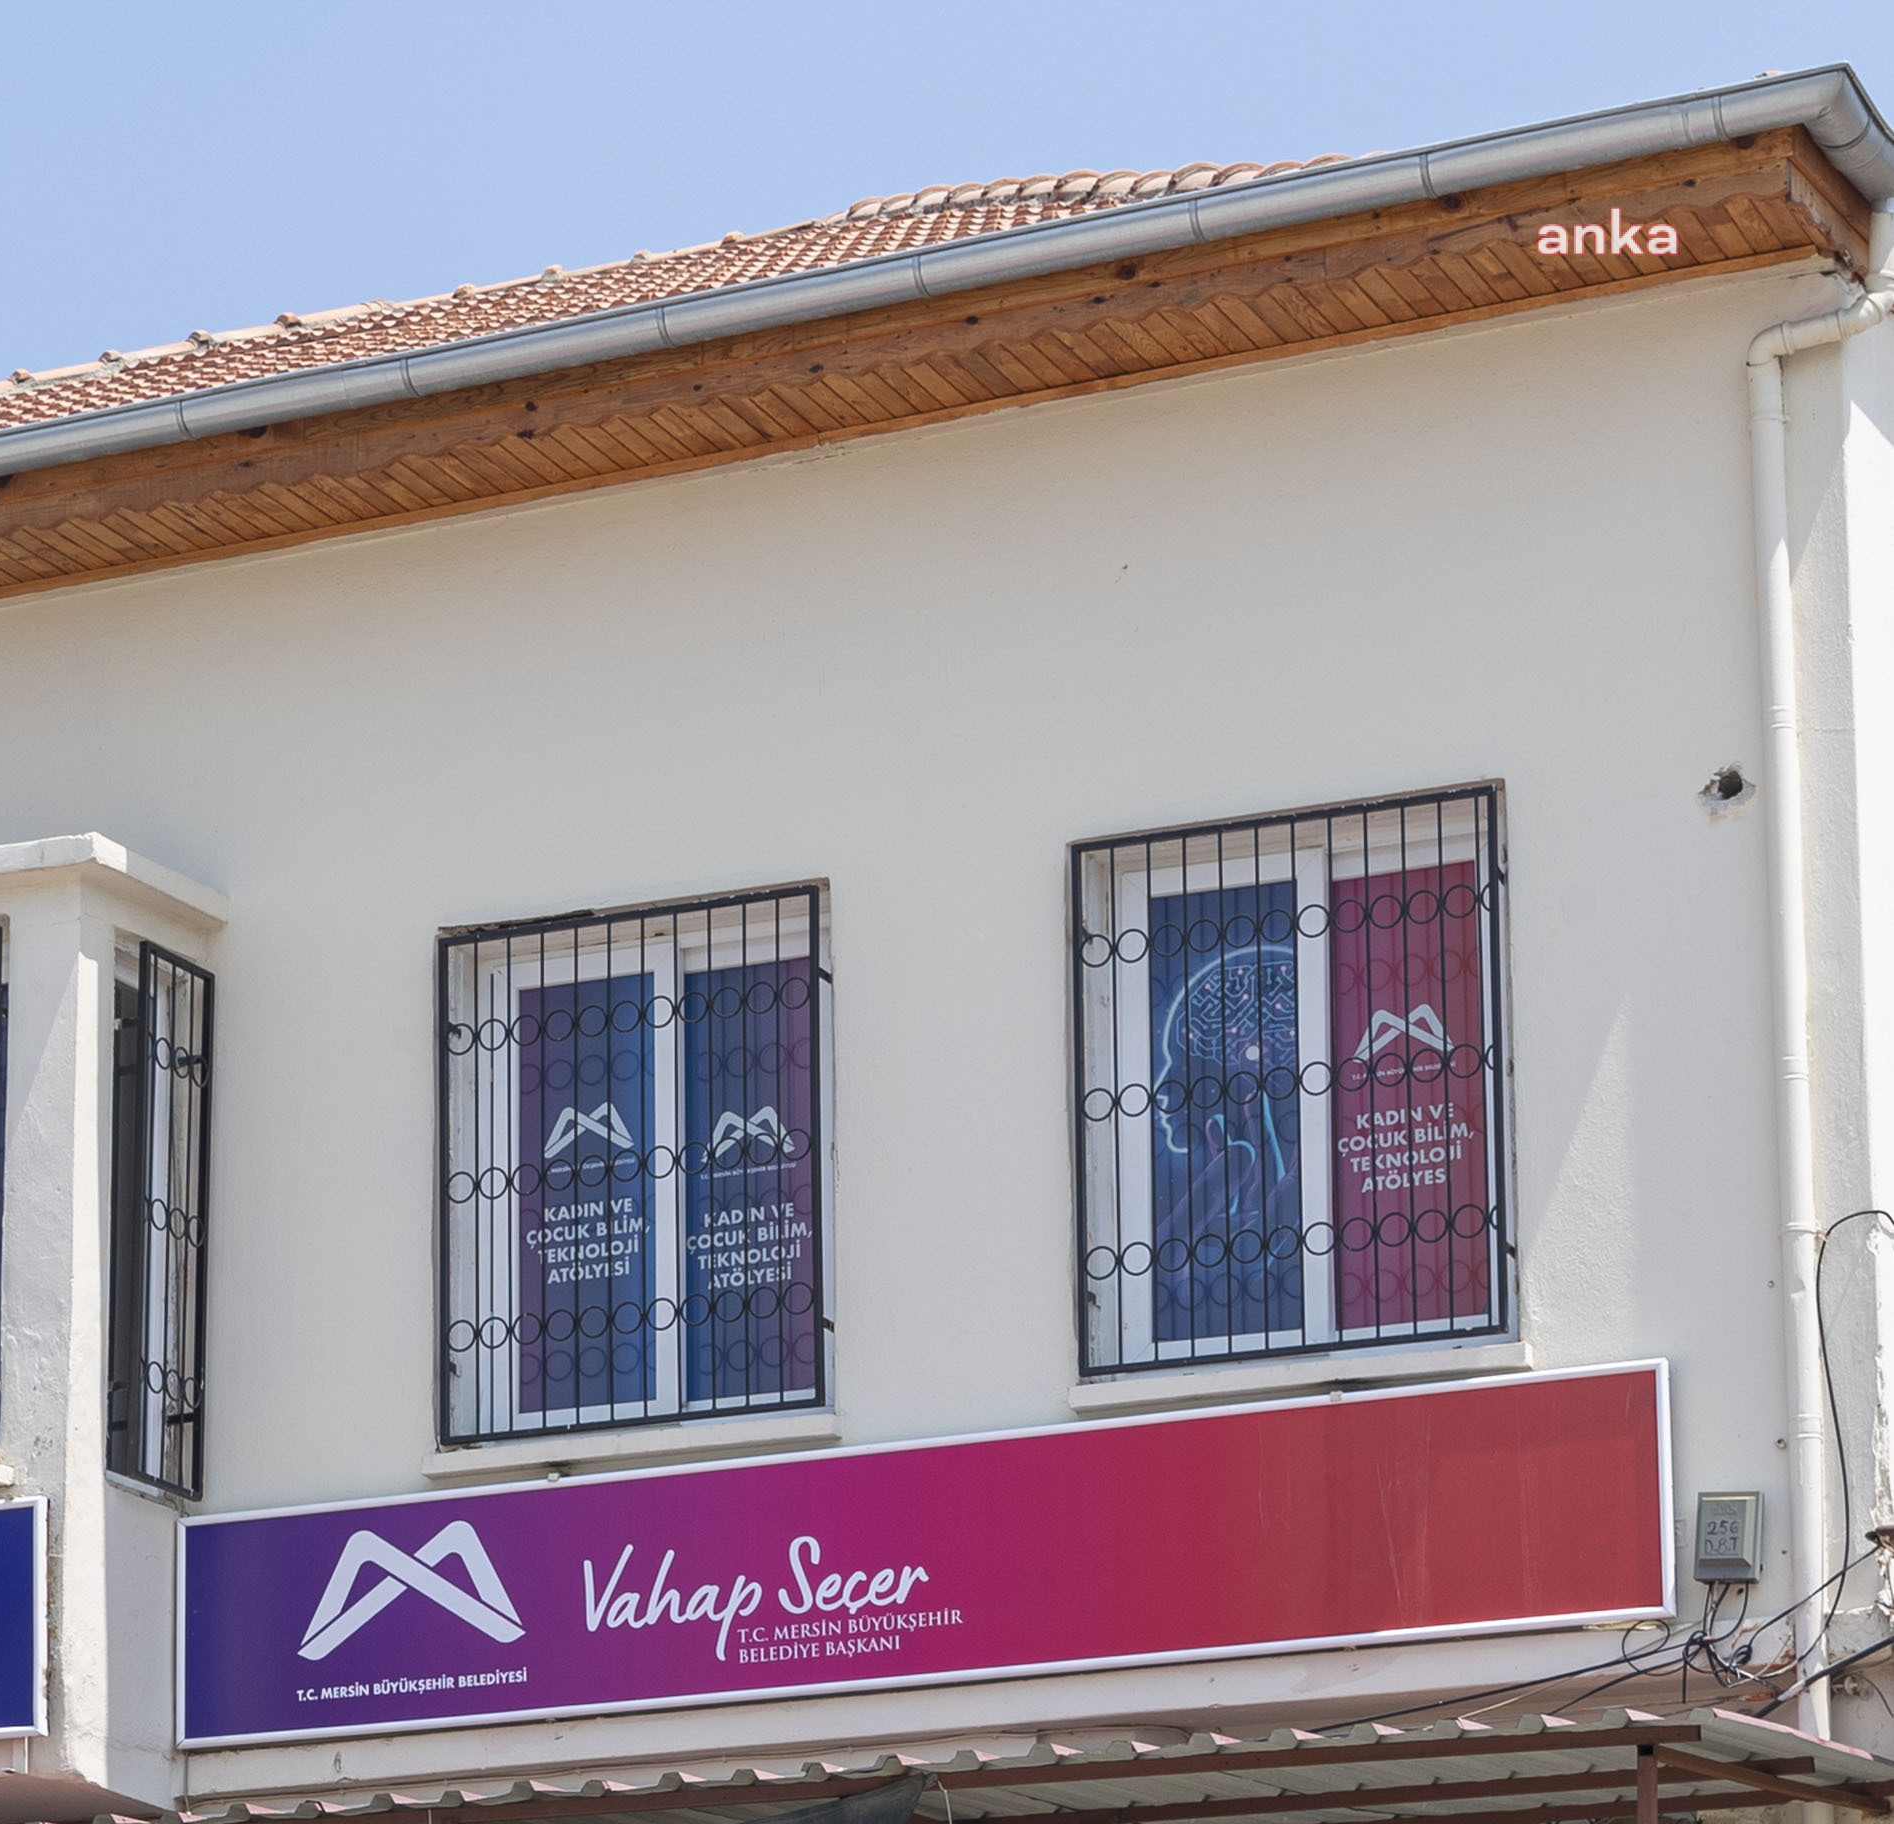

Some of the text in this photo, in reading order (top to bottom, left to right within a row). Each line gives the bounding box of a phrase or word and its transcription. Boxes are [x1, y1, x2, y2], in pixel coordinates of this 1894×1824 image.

[1356, 1106, 1422, 1130] KADIN
[1362, 1168, 1447, 1194] ATÖLYES
[544, 1198, 633, 1223] KADIN VE
[526, 1215, 651, 1250] ÇOCUK BLİM,
[583, 1535, 930, 1662] Vahap Seçer
[737, 1607, 964, 1645] T.C. MERSİN BÜYÜKŞEHİR
[738, 1635, 901, 1664] BELEDİYE BAŞKANI
[297, 1666, 527, 1702] T.C. MERSİN BÜYÜKŞEHİR BELEDİYESİ
